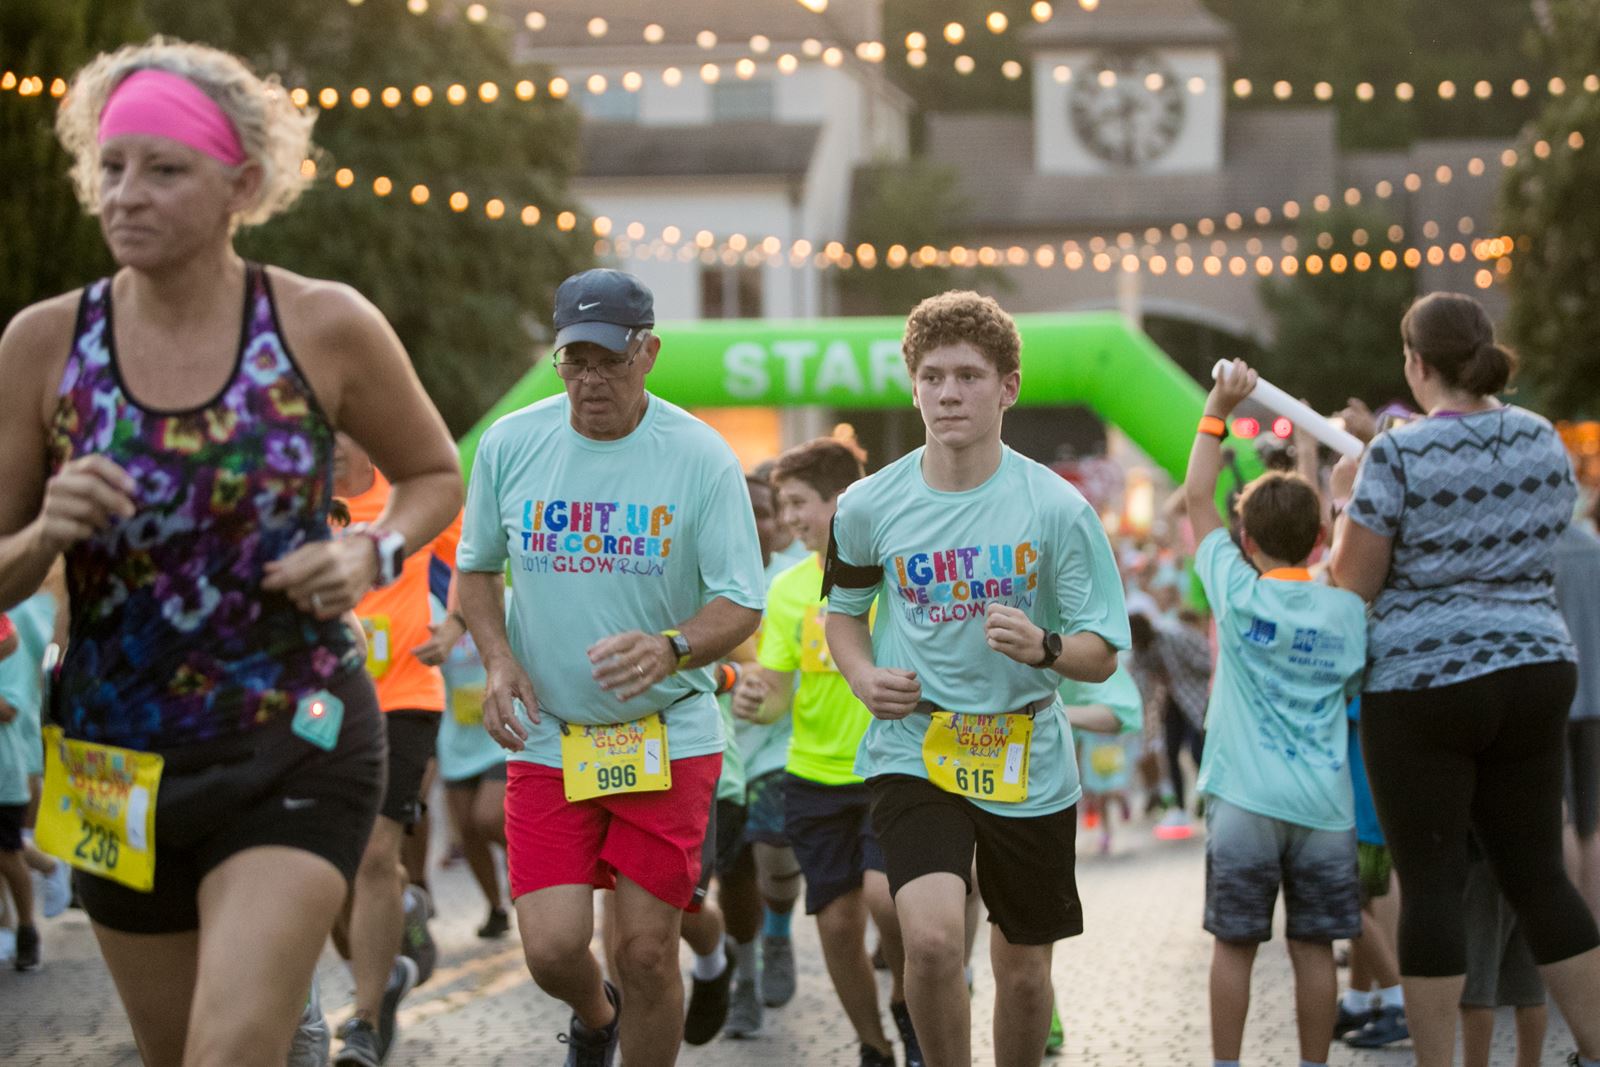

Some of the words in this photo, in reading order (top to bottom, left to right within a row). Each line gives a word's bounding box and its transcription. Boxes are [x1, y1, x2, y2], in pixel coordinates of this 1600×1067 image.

[723, 339, 912, 398] STAR
[522, 500, 618, 533] LIGHT
[626, 503, 674, 537] UP
[521, 532, 557, 552] THE
[564, 533, 672, 558] CORNERS
[553, 555, 616, 574] GLOW
[618, 557, 666, 576] RUN
[989, 541, 1038, 577] UP
[933, 573, 1038, 603] CORNERS
[929, 601, 986, 624] GLOW
[594, 734, 643, 748] GLOW
[959, 733, 1008, 748] GLOW
[969, 746, 1000, 758] RUN
[597, 764, 637, 791] 996
[956, 767, 994, 795] 615
[75, 819, 120, 869] 236
